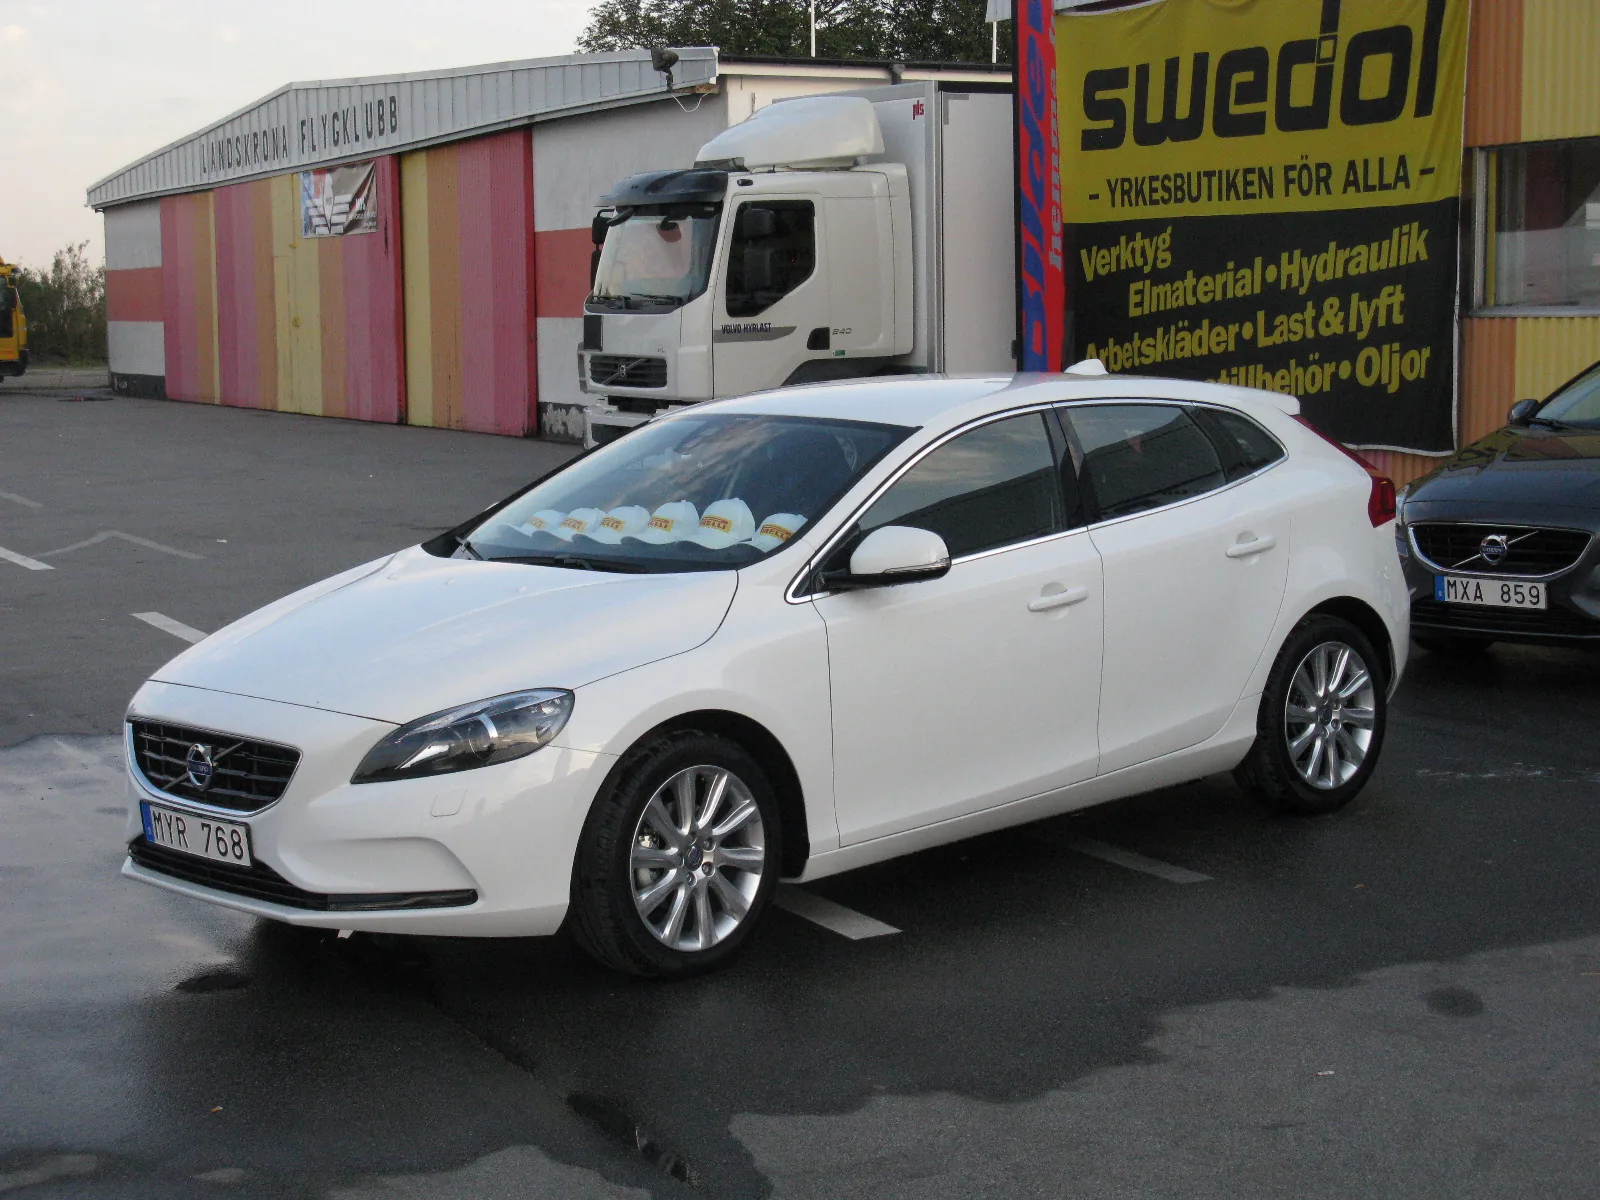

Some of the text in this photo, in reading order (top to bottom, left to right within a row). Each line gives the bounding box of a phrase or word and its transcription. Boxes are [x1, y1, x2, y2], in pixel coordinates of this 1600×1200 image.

[1080, 0, 1446, 151] swedol
[202, 95, 398, 174] LANDSKRONA FLYGKLUBB
[1106, 165, 1274, 208] YRKESBUTIKEN
[1284, 155, 1332, 197] FÖR
[1342, 154, 1411, 194] ALLA
[1080, 226, 1172, 283] Verktyg
[1128, 221, 1430, 318] Elmaterial Hydraulik
[721, 322, 772, 334] VOLVO HYRLAST
[832, 327, 852, 335] 240
[1085, 284, 1405, 373] Arbetskläder Last & lyft
[1355, 342, 1431, 394] Oljor
[1446, 580, 1484, 602] MXA
[1500, 583, 1540, 605] 859
[152, 810, 244, 860] MYR 768
